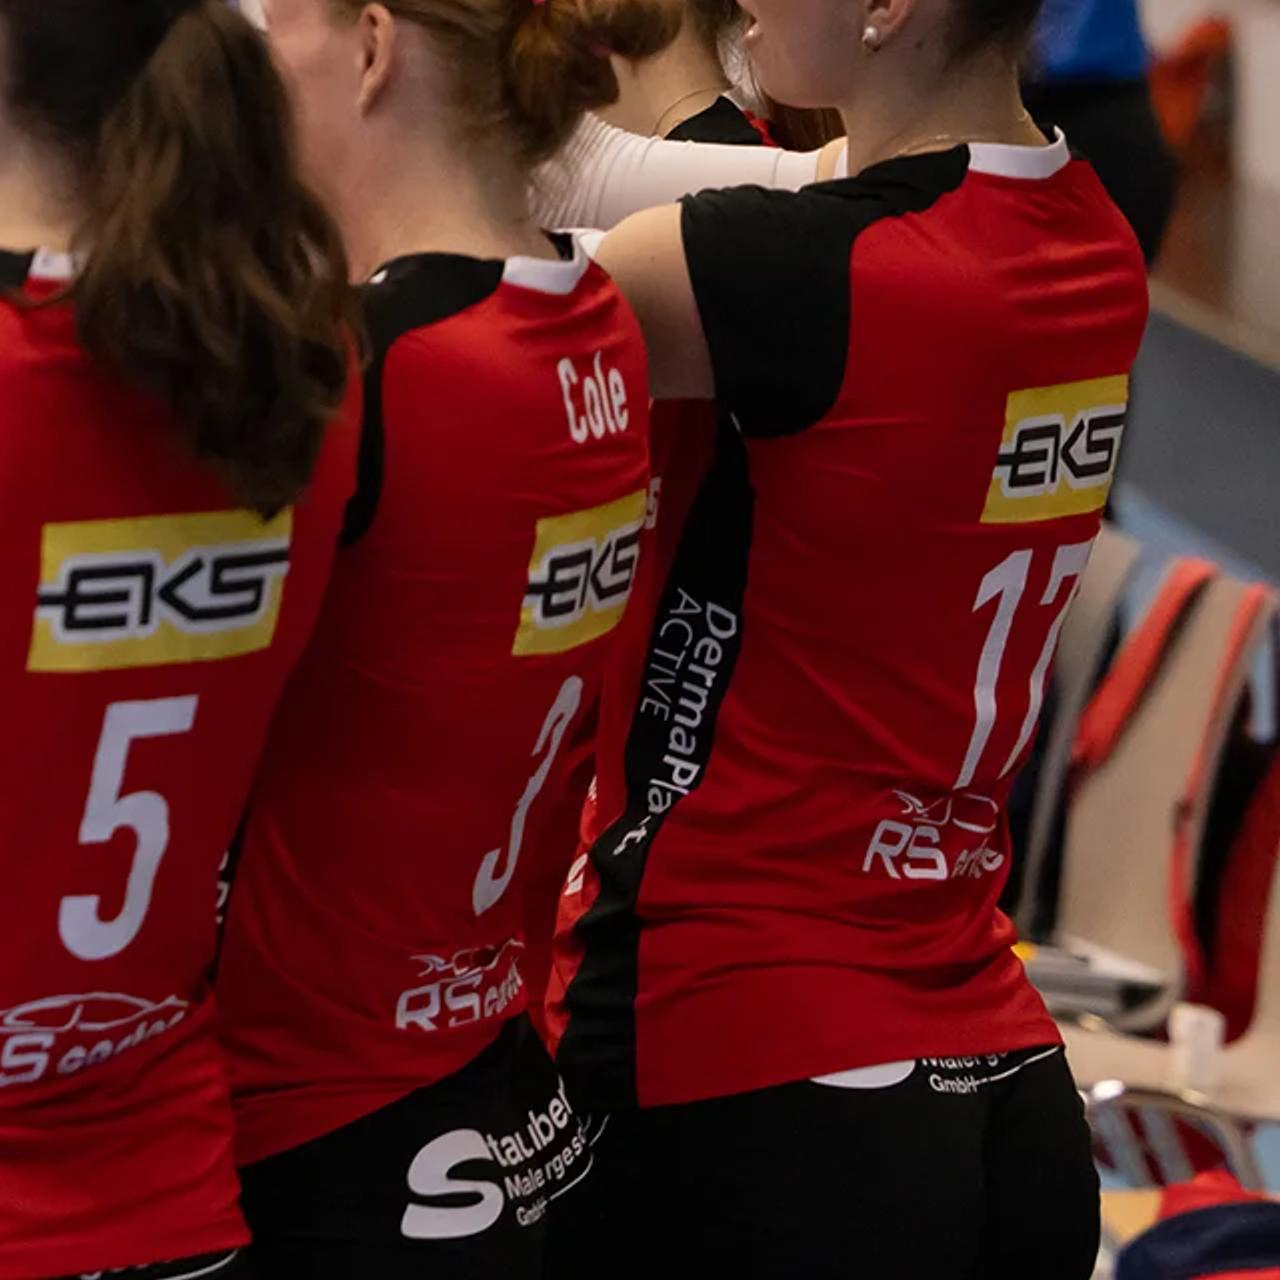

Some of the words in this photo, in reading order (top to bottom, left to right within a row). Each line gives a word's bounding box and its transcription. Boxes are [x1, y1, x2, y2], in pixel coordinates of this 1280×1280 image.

[557, 351, 629, 444] Cole
[997, 410, 1127, 489] EKS
[36, 546, 291, 631] EKS
[526, 532, 641, 619] EKS
[641, 587, 703, 721] ACTIVE
[947, 537, 1096, 791] 17
[58, 694, 199, 961] 5
[861, 819, 948, 881] RS
[395, 973, 483, 1032] RS
[929, 1073, 978, 1094] GmbH
